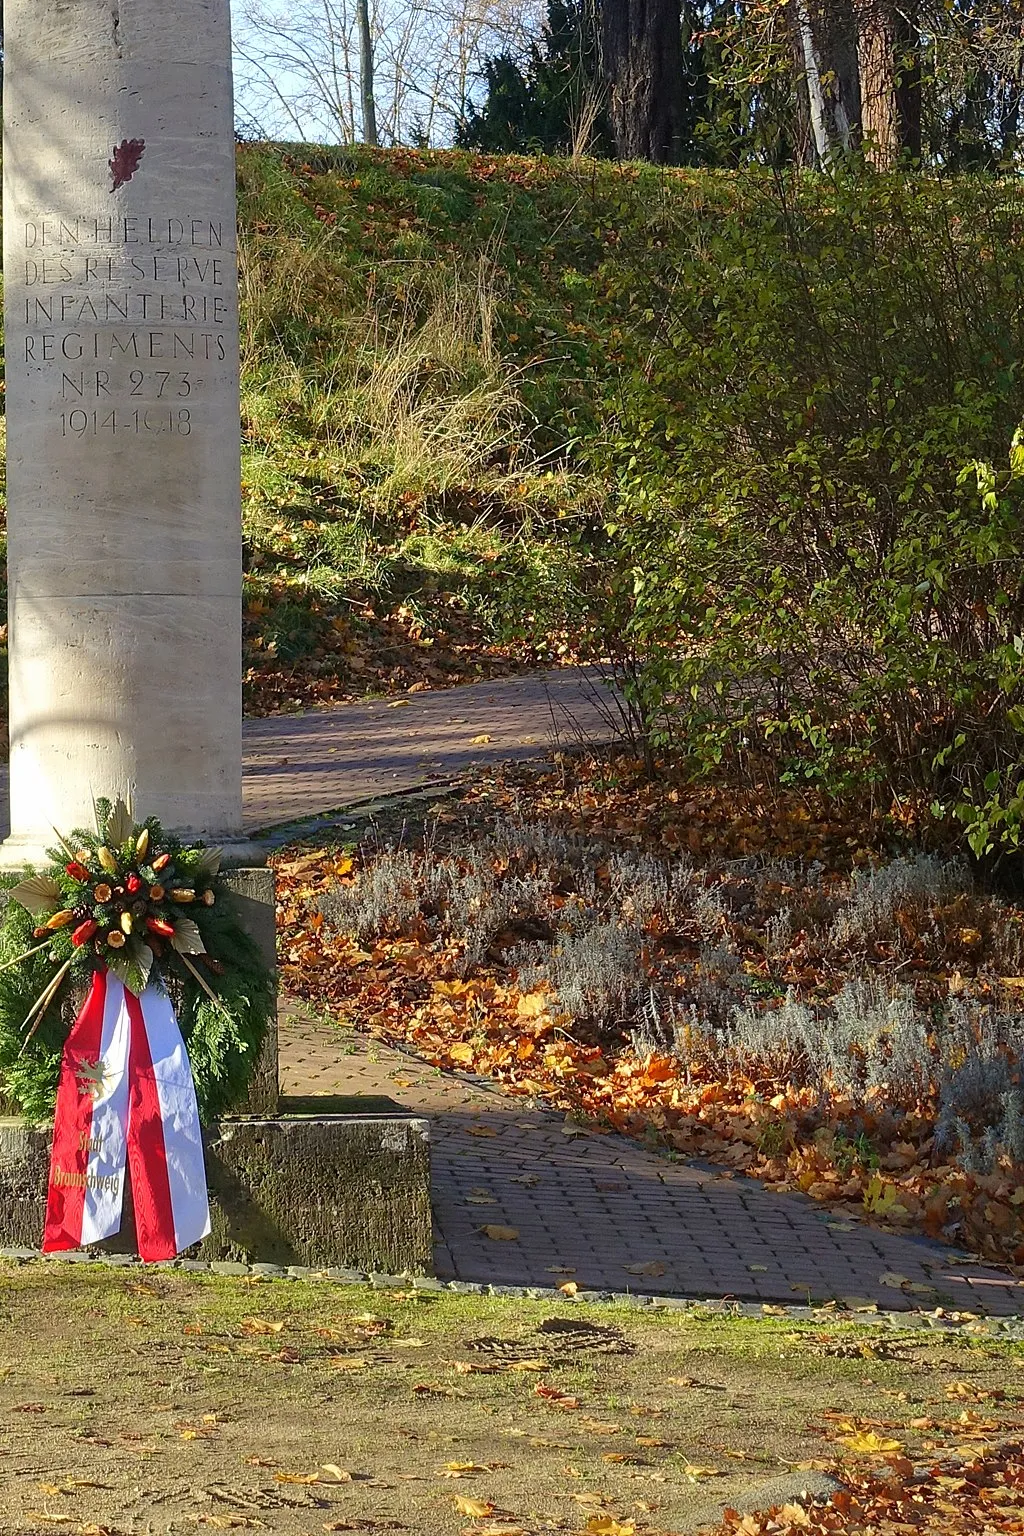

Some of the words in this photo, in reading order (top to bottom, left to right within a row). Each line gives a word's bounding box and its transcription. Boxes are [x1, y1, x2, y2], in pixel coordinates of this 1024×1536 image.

[25, 219, 79, 248] DEN
[94, 217, 223, 247] HELDEN
[25, 257, 73, 286] DES
[86, 256, 223, 286] RESERVE
[25, 332, 226, 362] REGIMENTS
[130, 371, 192, 398] 273
[79, 1132, 104, 1153] Stadt
[55, 1166, 120, 1196] Braunschweig
